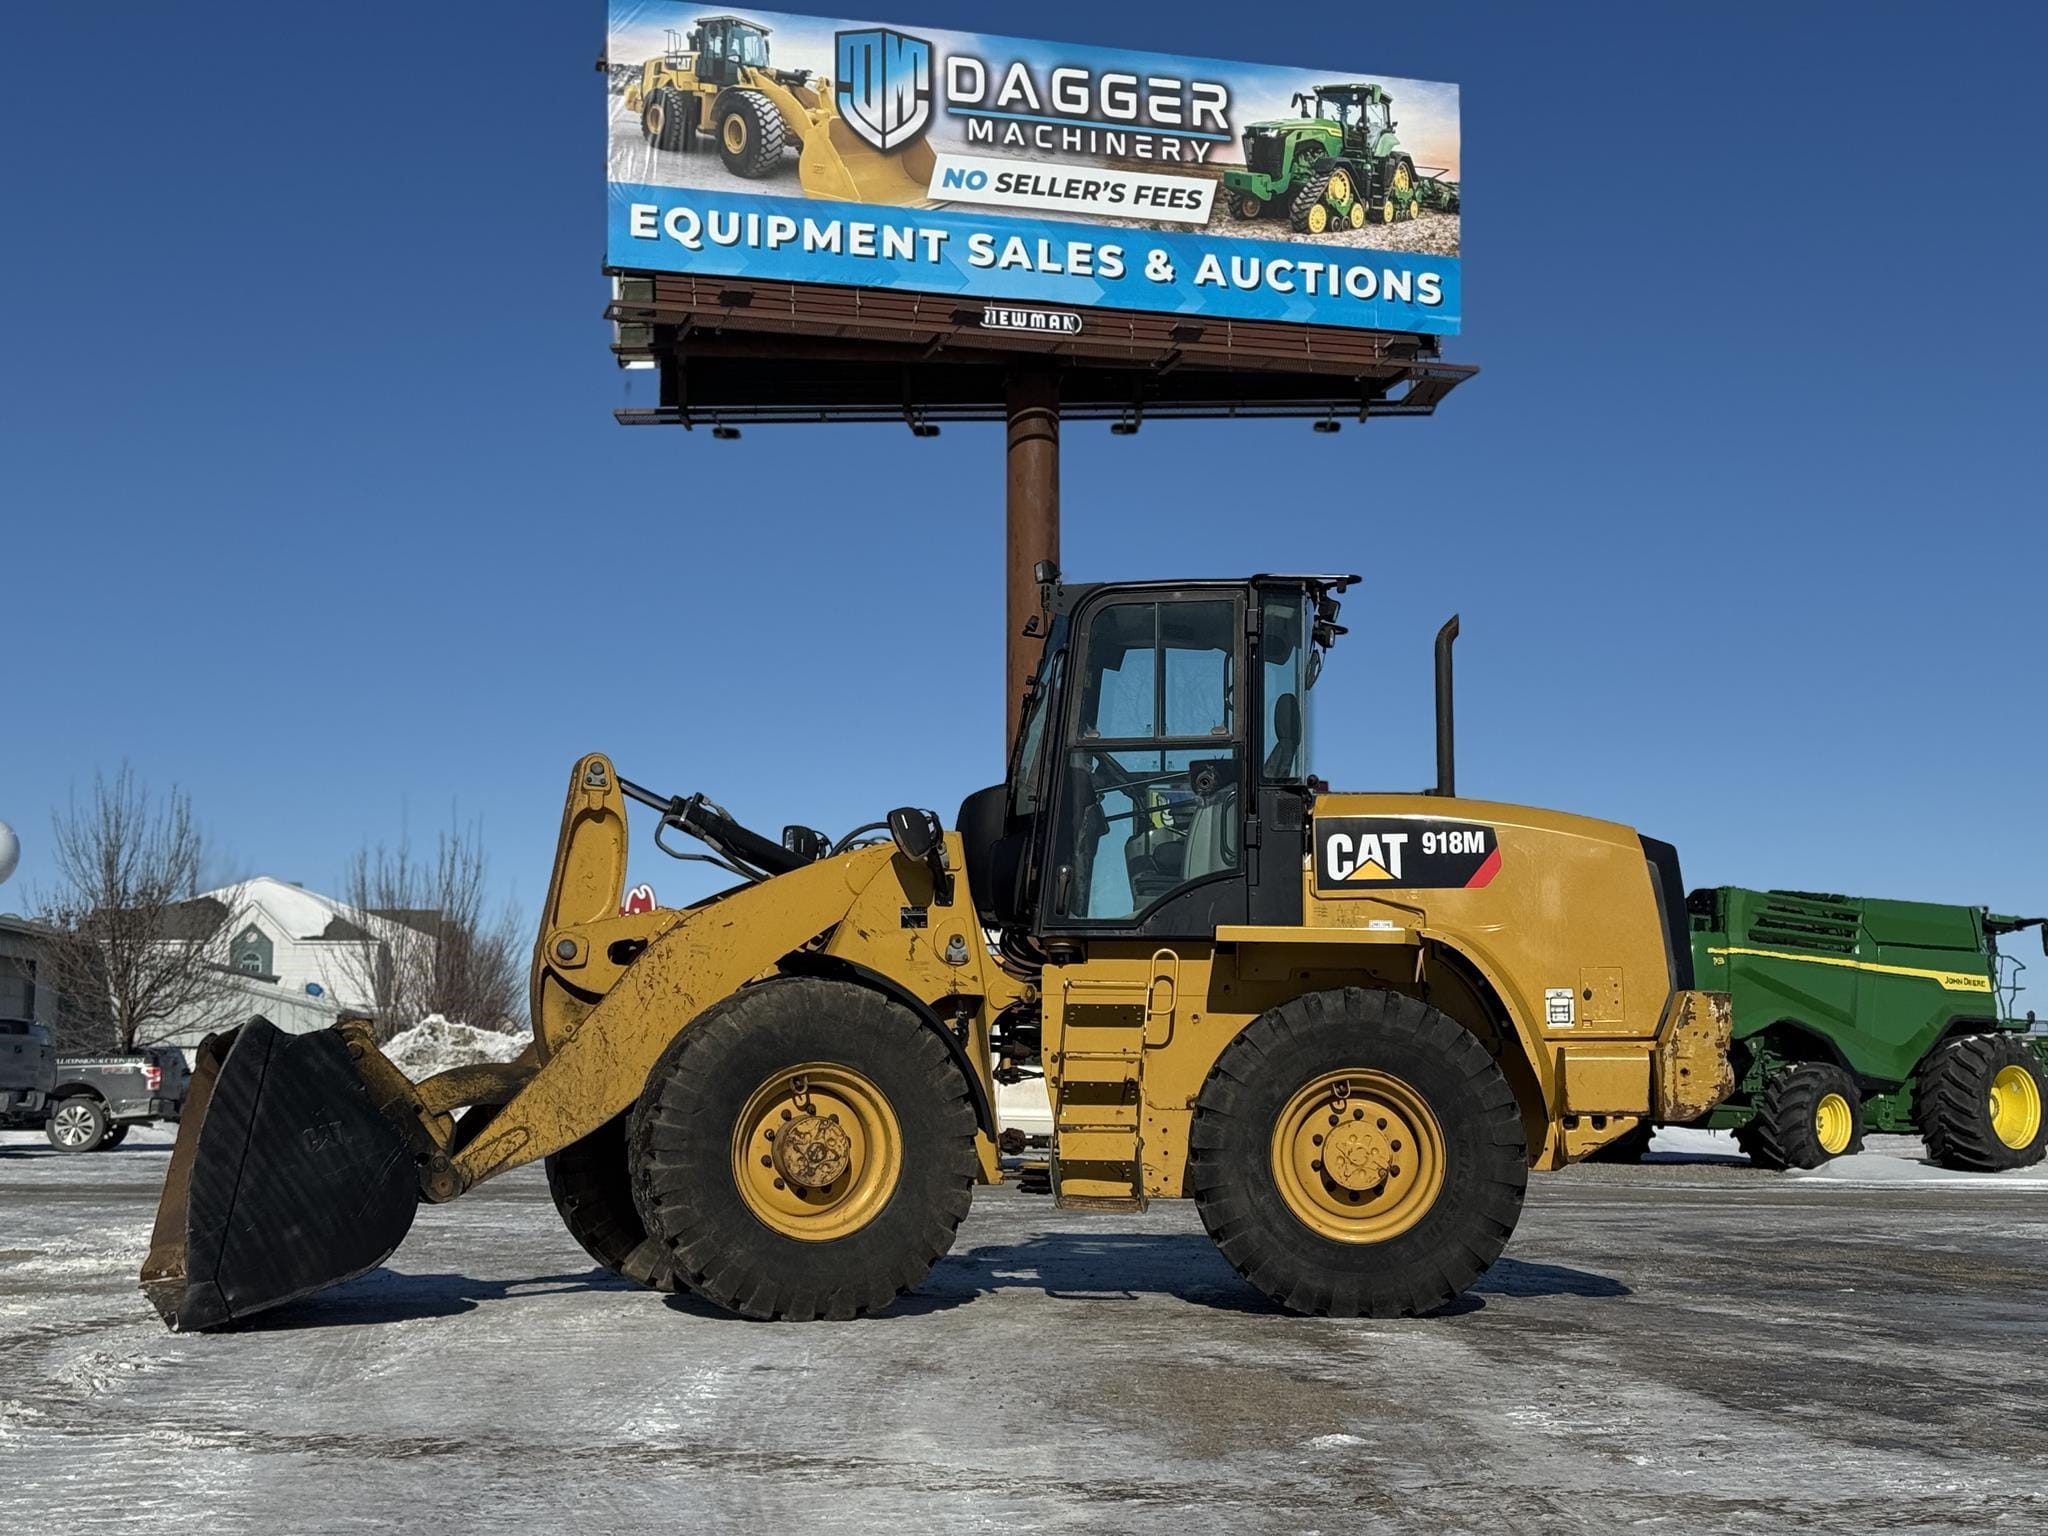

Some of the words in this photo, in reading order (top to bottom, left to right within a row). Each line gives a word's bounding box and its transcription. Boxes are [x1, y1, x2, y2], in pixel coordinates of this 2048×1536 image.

[947, 56, 1229, 129] DAGGER
[968, 118, 1210, 163] MACHINERY
[942, 168, 988, 191] NO
[995, 172, 1127, 203] SELLER'S
[1133, 185, 1203, 210] FEES
[630, 203, 949, 264] EQUIPMENT
[968, 233, 1126, 280] SALES
[1145, 249, 1176, 283] &
[1193, 253, 1443, 305] AUCTIONS
[984, 309, 1075, 331] NEWMAN
[1327, 833, 1408, 881] CAT
[1422, 831, 1485, 855] 918M
[1945, 976, 1963, 986] JOHN
[1963, 977, 1986, 987] DEERE
